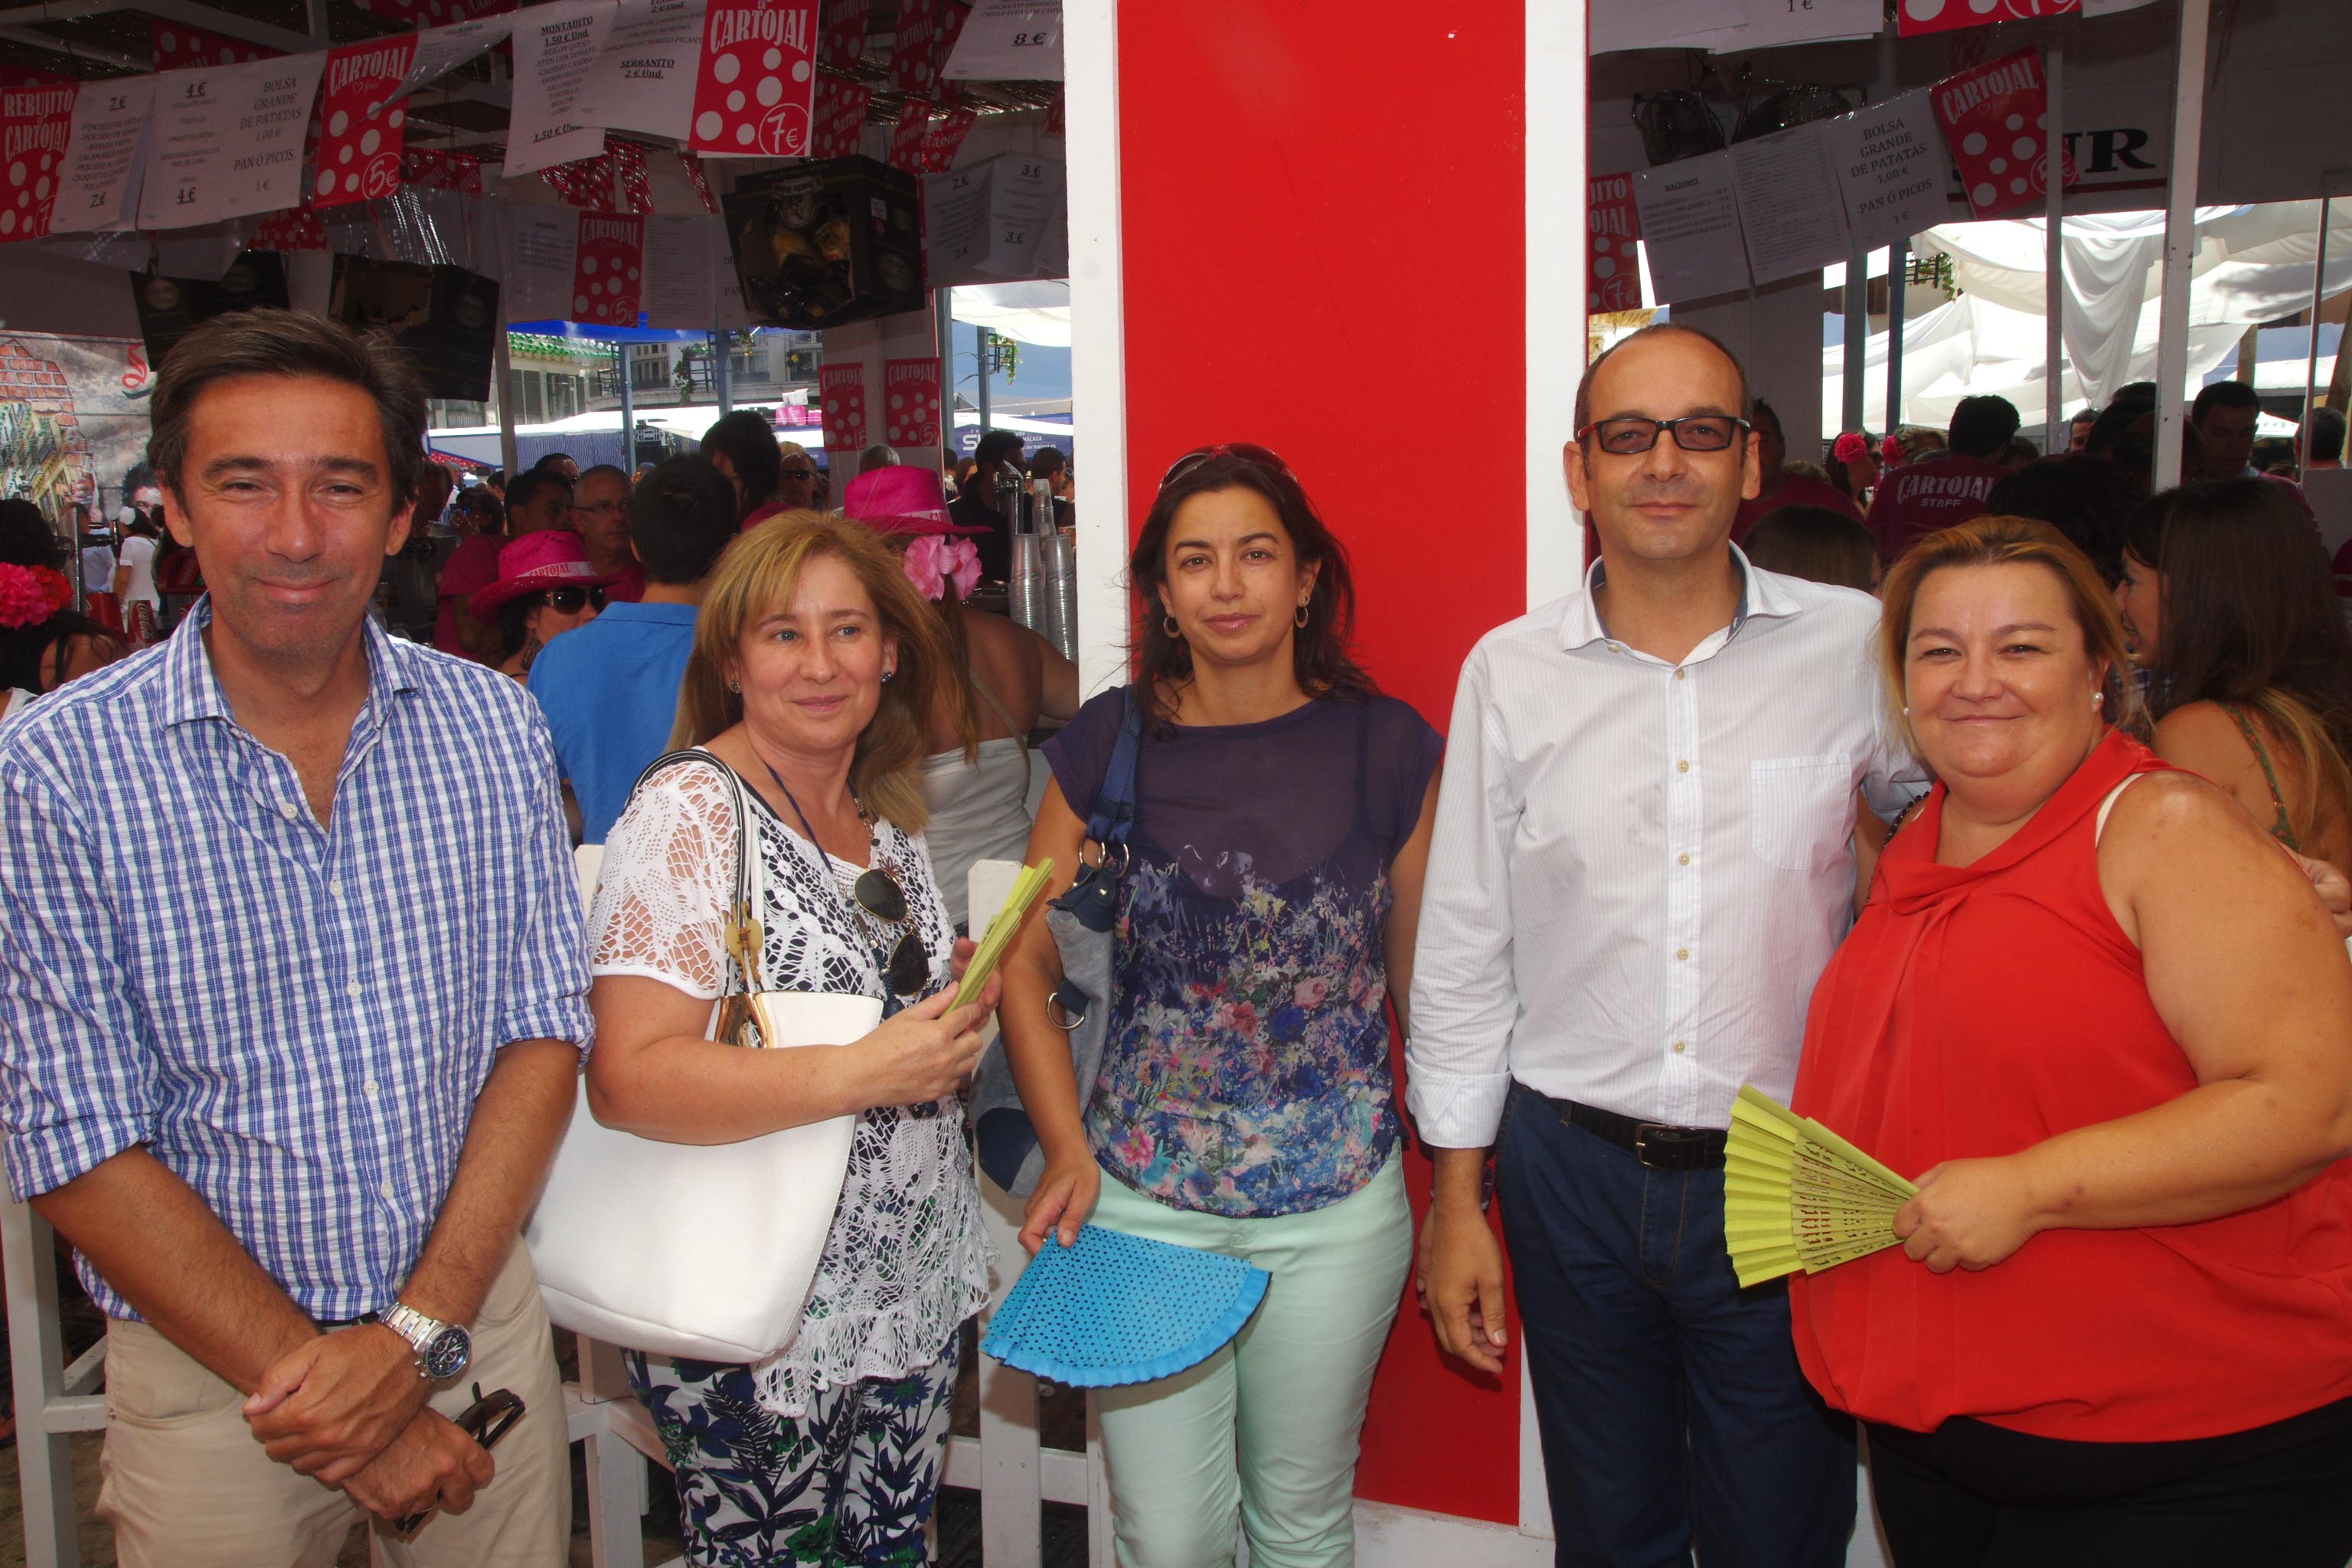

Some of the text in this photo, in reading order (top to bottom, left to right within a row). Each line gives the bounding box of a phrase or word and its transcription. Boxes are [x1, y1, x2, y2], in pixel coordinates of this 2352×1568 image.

[541, 16, 593, 36] MONTADITO
[710, 8, 808, 54] CARTOJAL
[1014, 32, 1046, 46] 8 €
[263, 77, 296, 93] BOLSA
[330, 46, 408, 97] CARTOJAL
[5, 88, 74, 117] REBUJITO
[253, 93, 297, 110] GRANDE
[1942, 57, 2040, 126] CARTOJAL
[240, 107, 302, 129] DE PATATAS
[1863, 118, 1905, 141] BOLSA
[5, 121, 68, 162] CARTOJAL
[767, 111, 799, 154] 7€
[1860, 132, 1913, 158] GRANDE
[234, 155, 254, 172] PAN
[266, 149, 294, 165] PICOS
[1851, 142, 1926, 178] DE PATATAS
[369, 161, 400, 198] 5€
[1590, 178, 1627, 205] JITO
[1664, 178, 1699, 191] RACIONES
[1860, 197, 1884, 214] PAN
[1898, 178, 1933, 201] PICOS
[583, 218, 639, 249] CARTOJAL
[1590, 206, 1631, 239] OJAL
[888, 363, 937, 387] CARTOJAL
